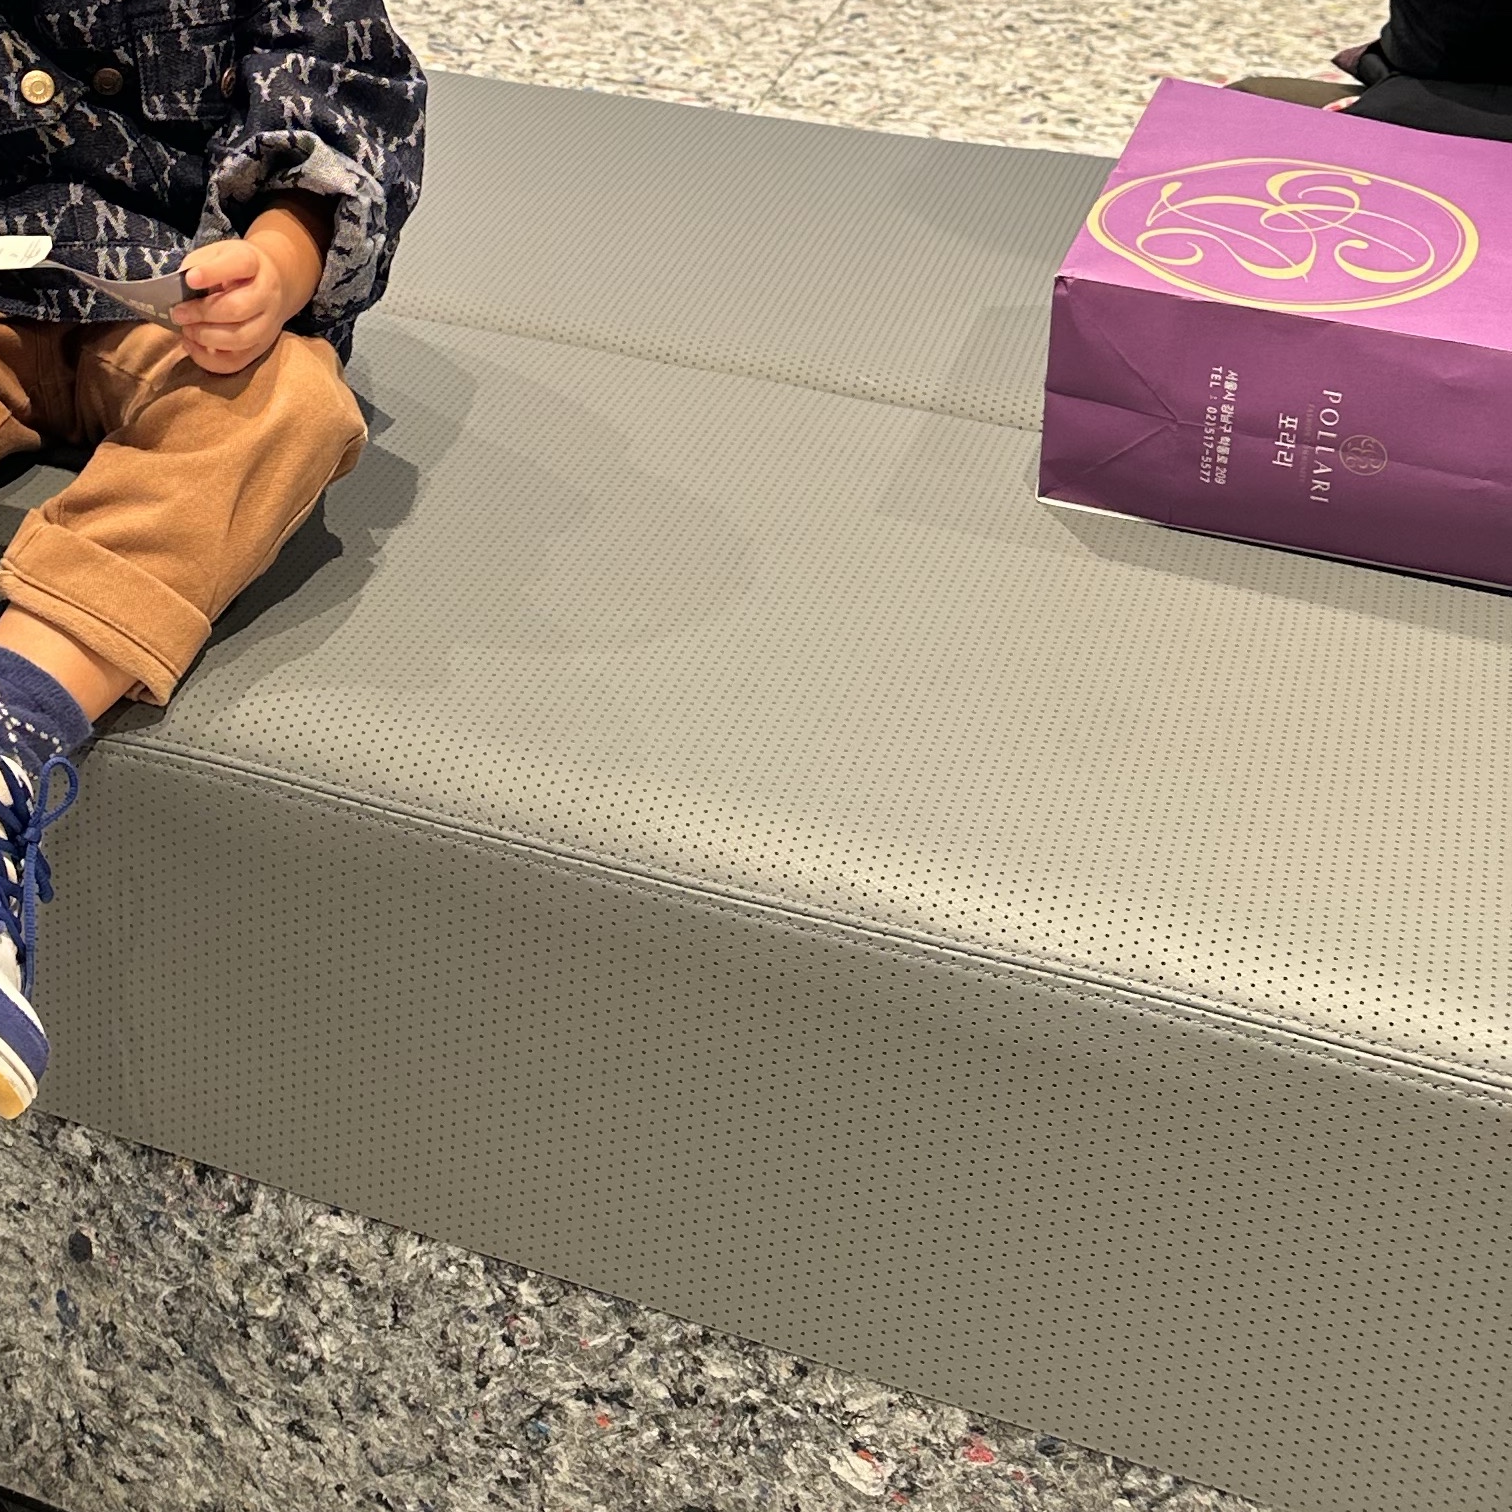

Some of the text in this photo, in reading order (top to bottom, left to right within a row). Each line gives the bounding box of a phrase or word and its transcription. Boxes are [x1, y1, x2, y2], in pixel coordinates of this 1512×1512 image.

[1209, 366, 1223, 388] TEL
[1222, 369, 1238, 402] 서울시
[1199, 405, 1219, 484] 02)517-5577
[1272, 412, 1298, 468] 포라리
[1310, 389, 1343, 503] POLLARI
[1214, 467, 1228, 485] 209
